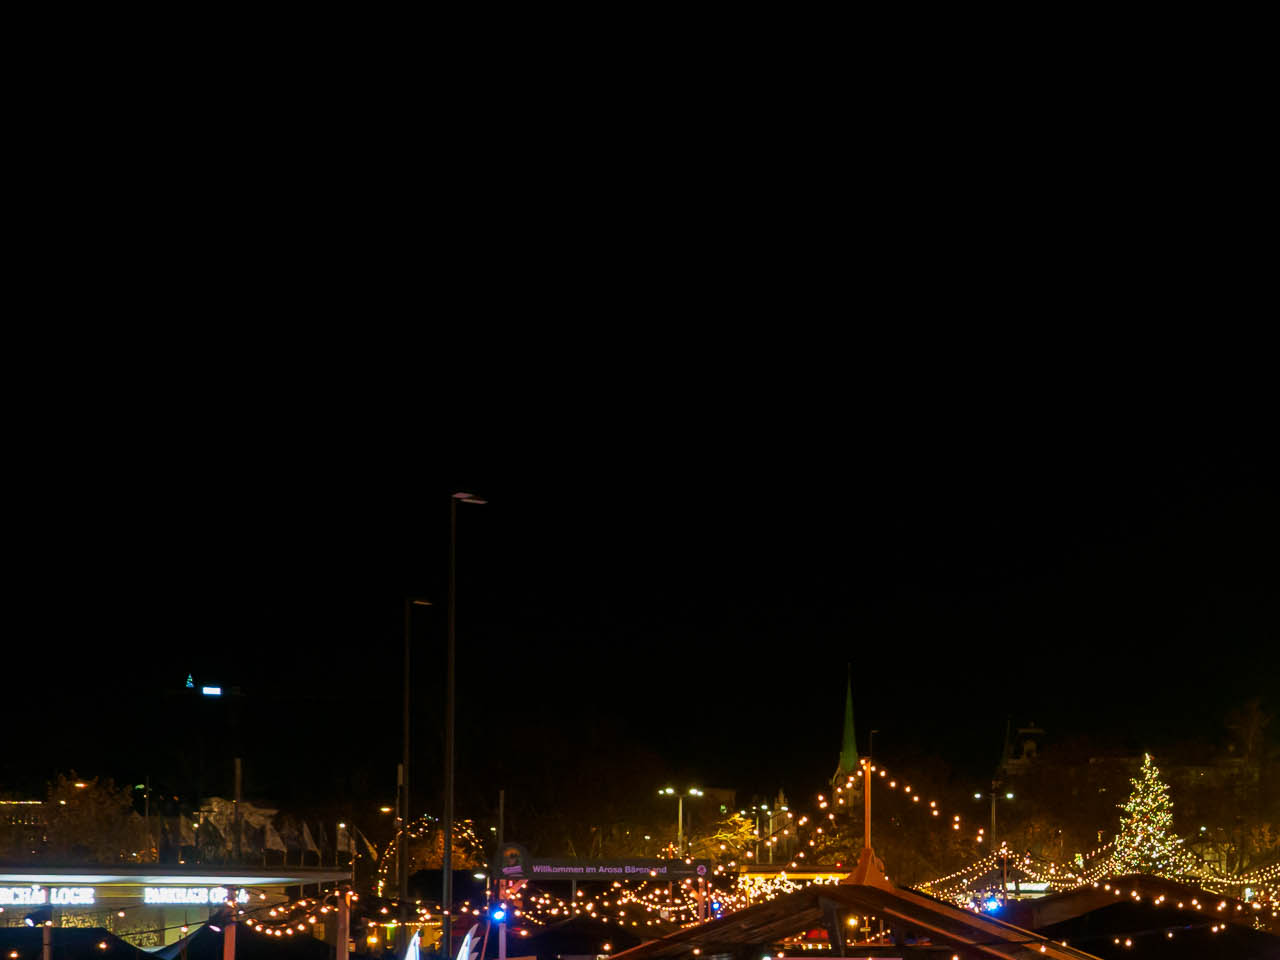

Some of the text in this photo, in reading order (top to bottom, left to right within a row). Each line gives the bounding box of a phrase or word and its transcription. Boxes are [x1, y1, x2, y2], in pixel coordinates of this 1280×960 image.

[532, 864, 584, 874] Willkommen
[586, 864, 597, 874] im
[599, 864, 623, 874] Arosa
